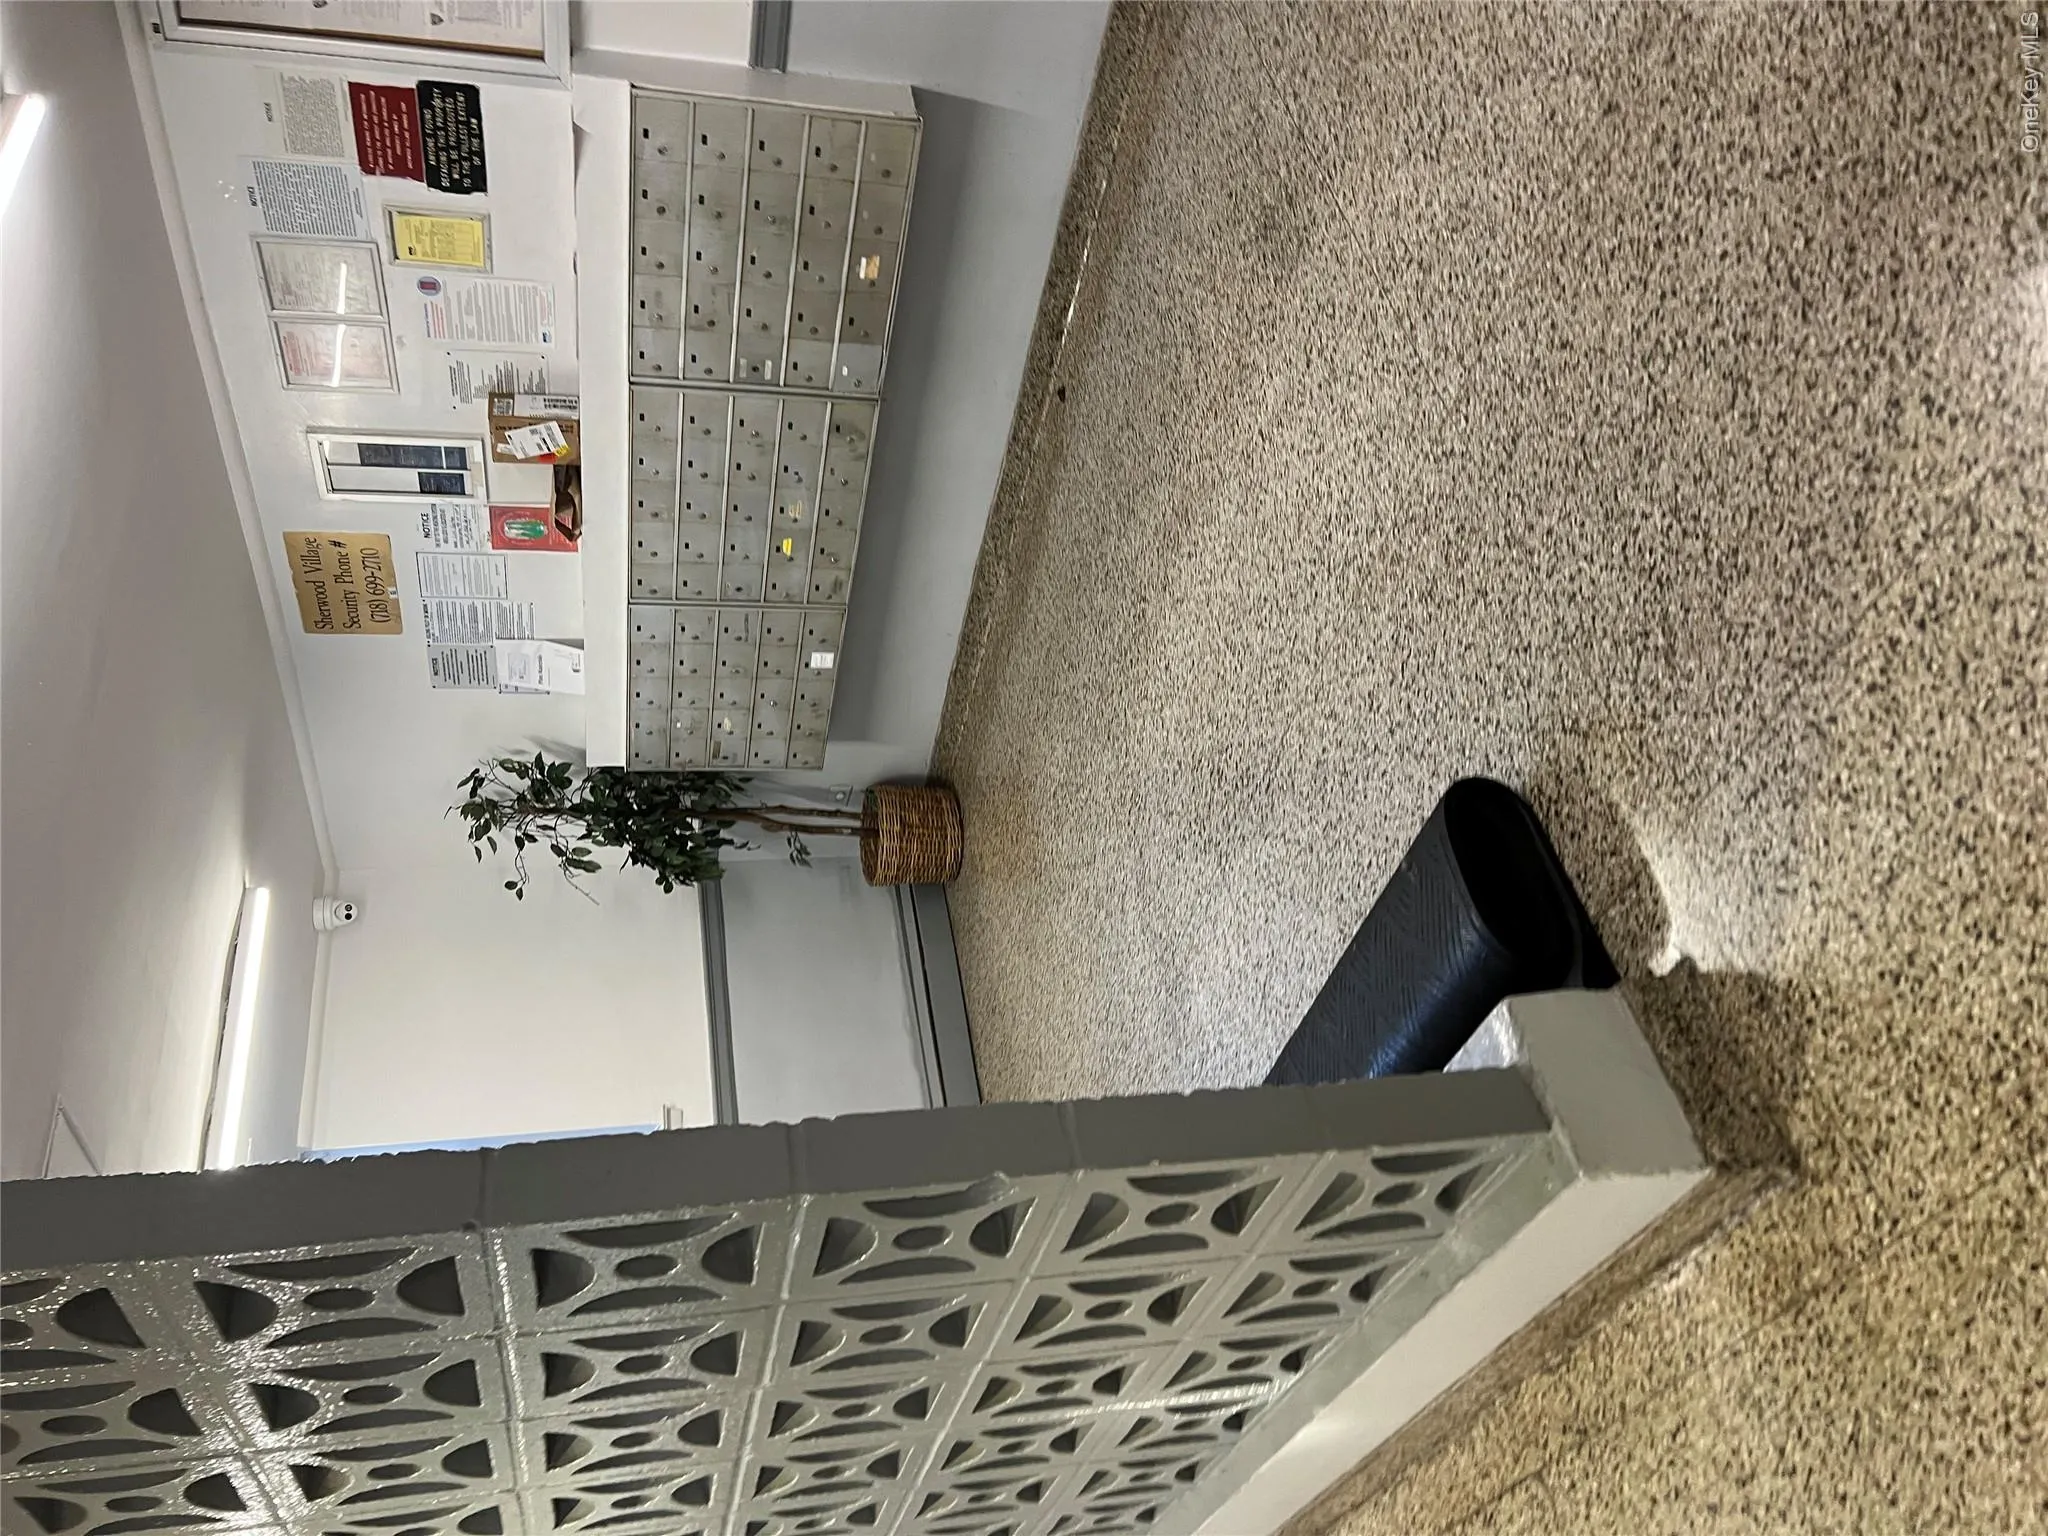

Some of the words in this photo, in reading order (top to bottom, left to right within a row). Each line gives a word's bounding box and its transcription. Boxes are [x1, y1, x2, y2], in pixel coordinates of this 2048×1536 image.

[432, 88, 444, 127] PROPERTY
[456, 91, 466, 121] EXTENT
[423, 108, 434, 134] FOUND
[445, 97, 457, 146] PROSECUTED
[470, 118, 479, 134] LAW
[426, 137, 436, 165] ANYONE
[437, 130, 446, 147] THIS
[459, 124, 469, 157] FULLEST
[471, 137, 480, 151] THE
[450, 149, 458, 159] BE
[473, 156, 481, 165] OF
[439, 151, 450, 187] DEFACING
[451, 162, 460, 179] WILL
[462, 161, 470, 174] THE
[464, 178, 472, 187] TO
[421, 513, 430, 538] NOTICE
[300, 537, 323, 574] Village
[328, 540, 347, 549] #
[333, 551, 354, 584] Phone
[360, 548, 385, 596] 699-2710
[304, 580, 334, 630] Sherwood
[341, 590, 361, 629] Security
[366, 599, 391, 623] (718)
